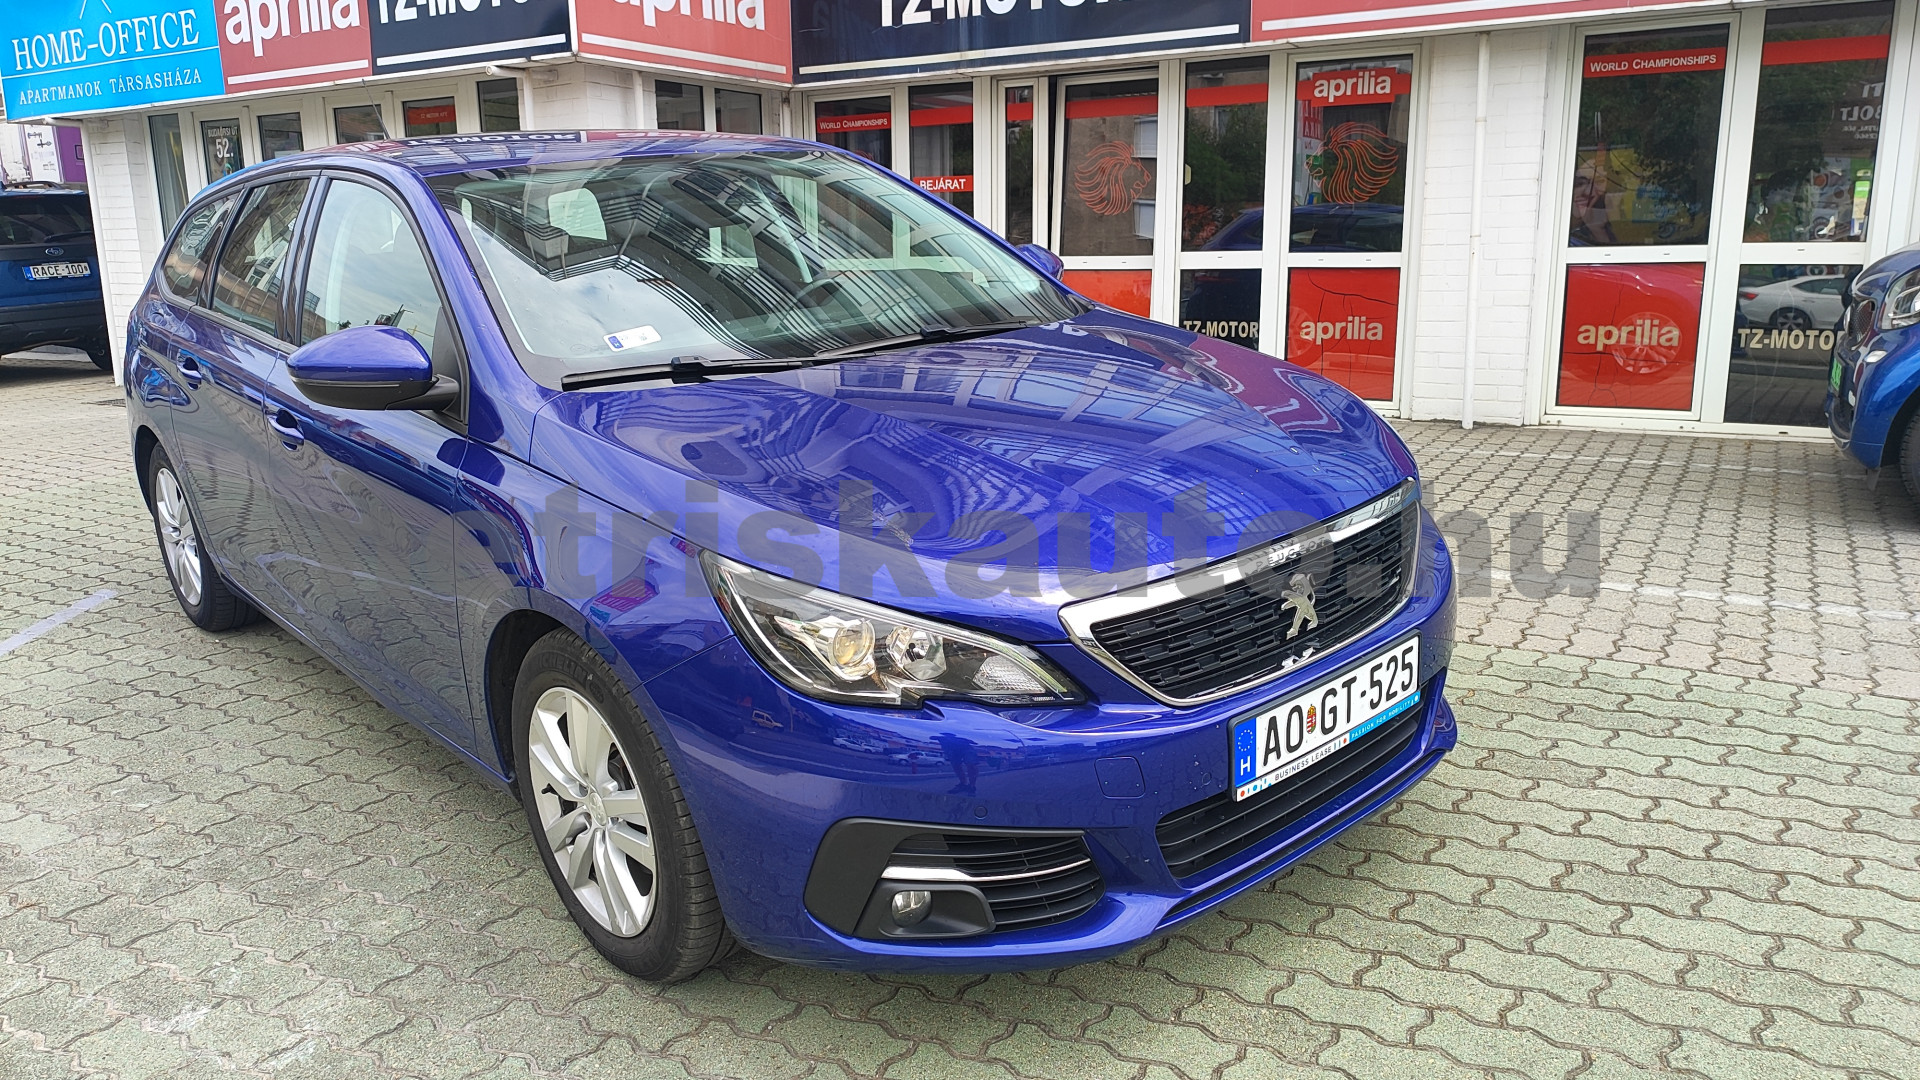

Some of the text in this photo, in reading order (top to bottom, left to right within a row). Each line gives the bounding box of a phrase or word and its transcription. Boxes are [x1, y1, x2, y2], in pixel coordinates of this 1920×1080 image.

[11, 9, 200, 71] HOME-OFFICE
[19, 67, 202, 105] APARTMANOK TÁRSASHÁZA
[1313, 71, 1391, 102] aprilia
[215, 138, 234, 158] 52.
[919, 177, 967, 191] BEJÁRAT
[32, 264, 83, 278] RACE-100
[1183, 320, 1259, 338] TZ-MOTOR
[1300, 316, 1383, 345] aprilia
[1577, 319, 1679, 351] aprilia
[1262, 645, 1414, 767] AO GT-525
[1274, 746, 1332, 781] BUSINESS LEASE
